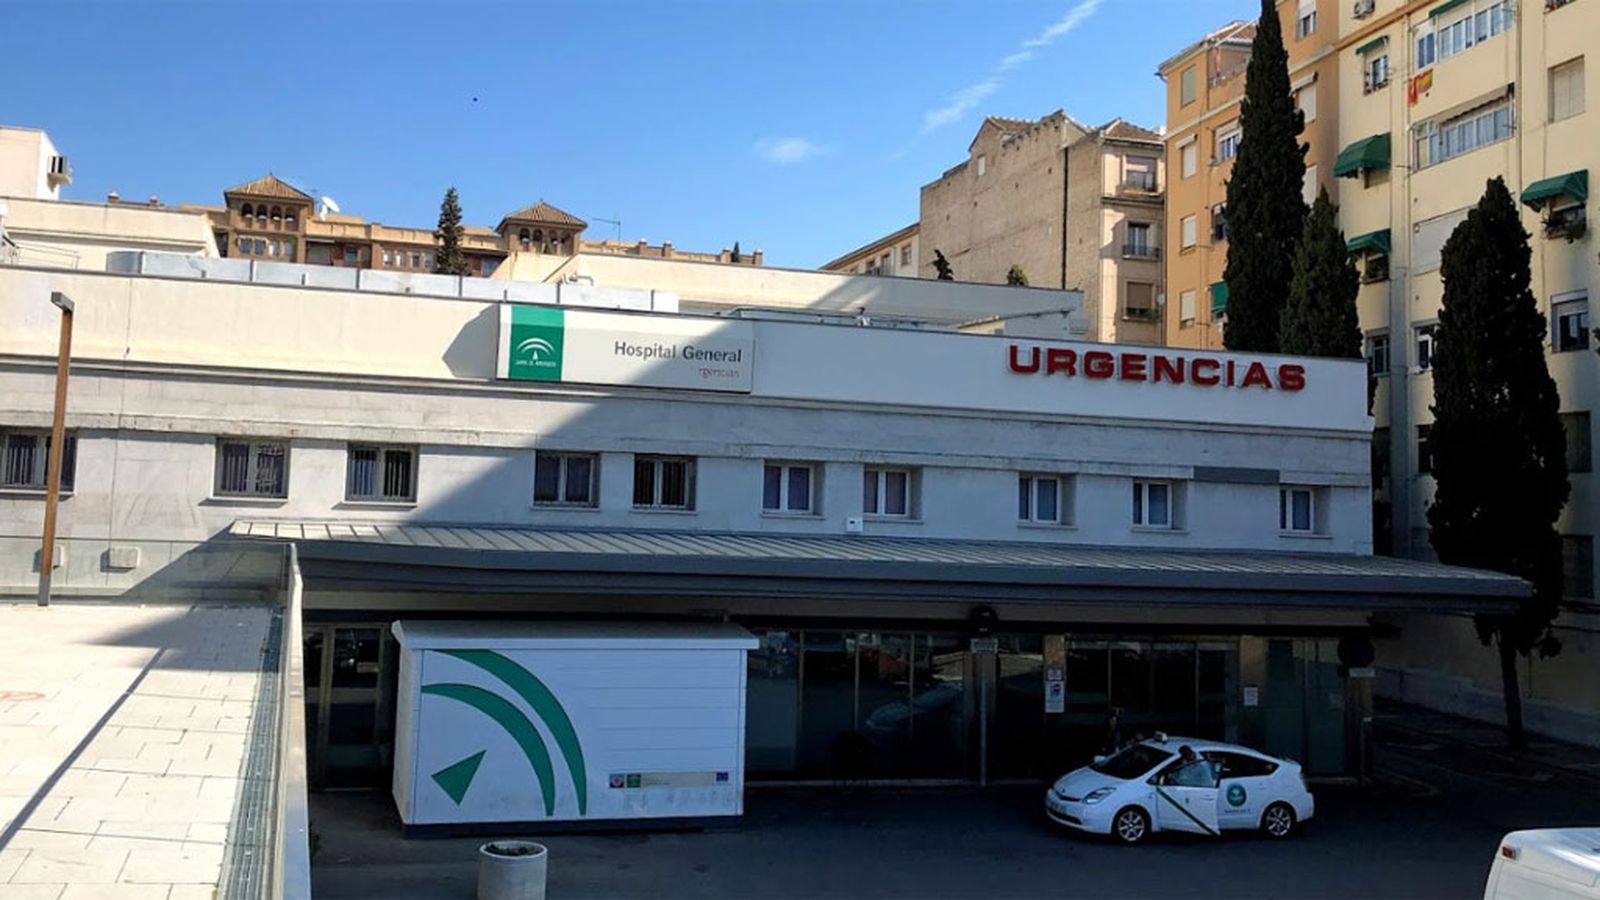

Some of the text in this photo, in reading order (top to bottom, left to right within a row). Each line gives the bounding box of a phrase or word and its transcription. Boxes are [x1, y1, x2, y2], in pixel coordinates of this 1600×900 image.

[614, 340, 742, 363] Hospital General
[1008, 344, 1307, 392] URGENCIAS
